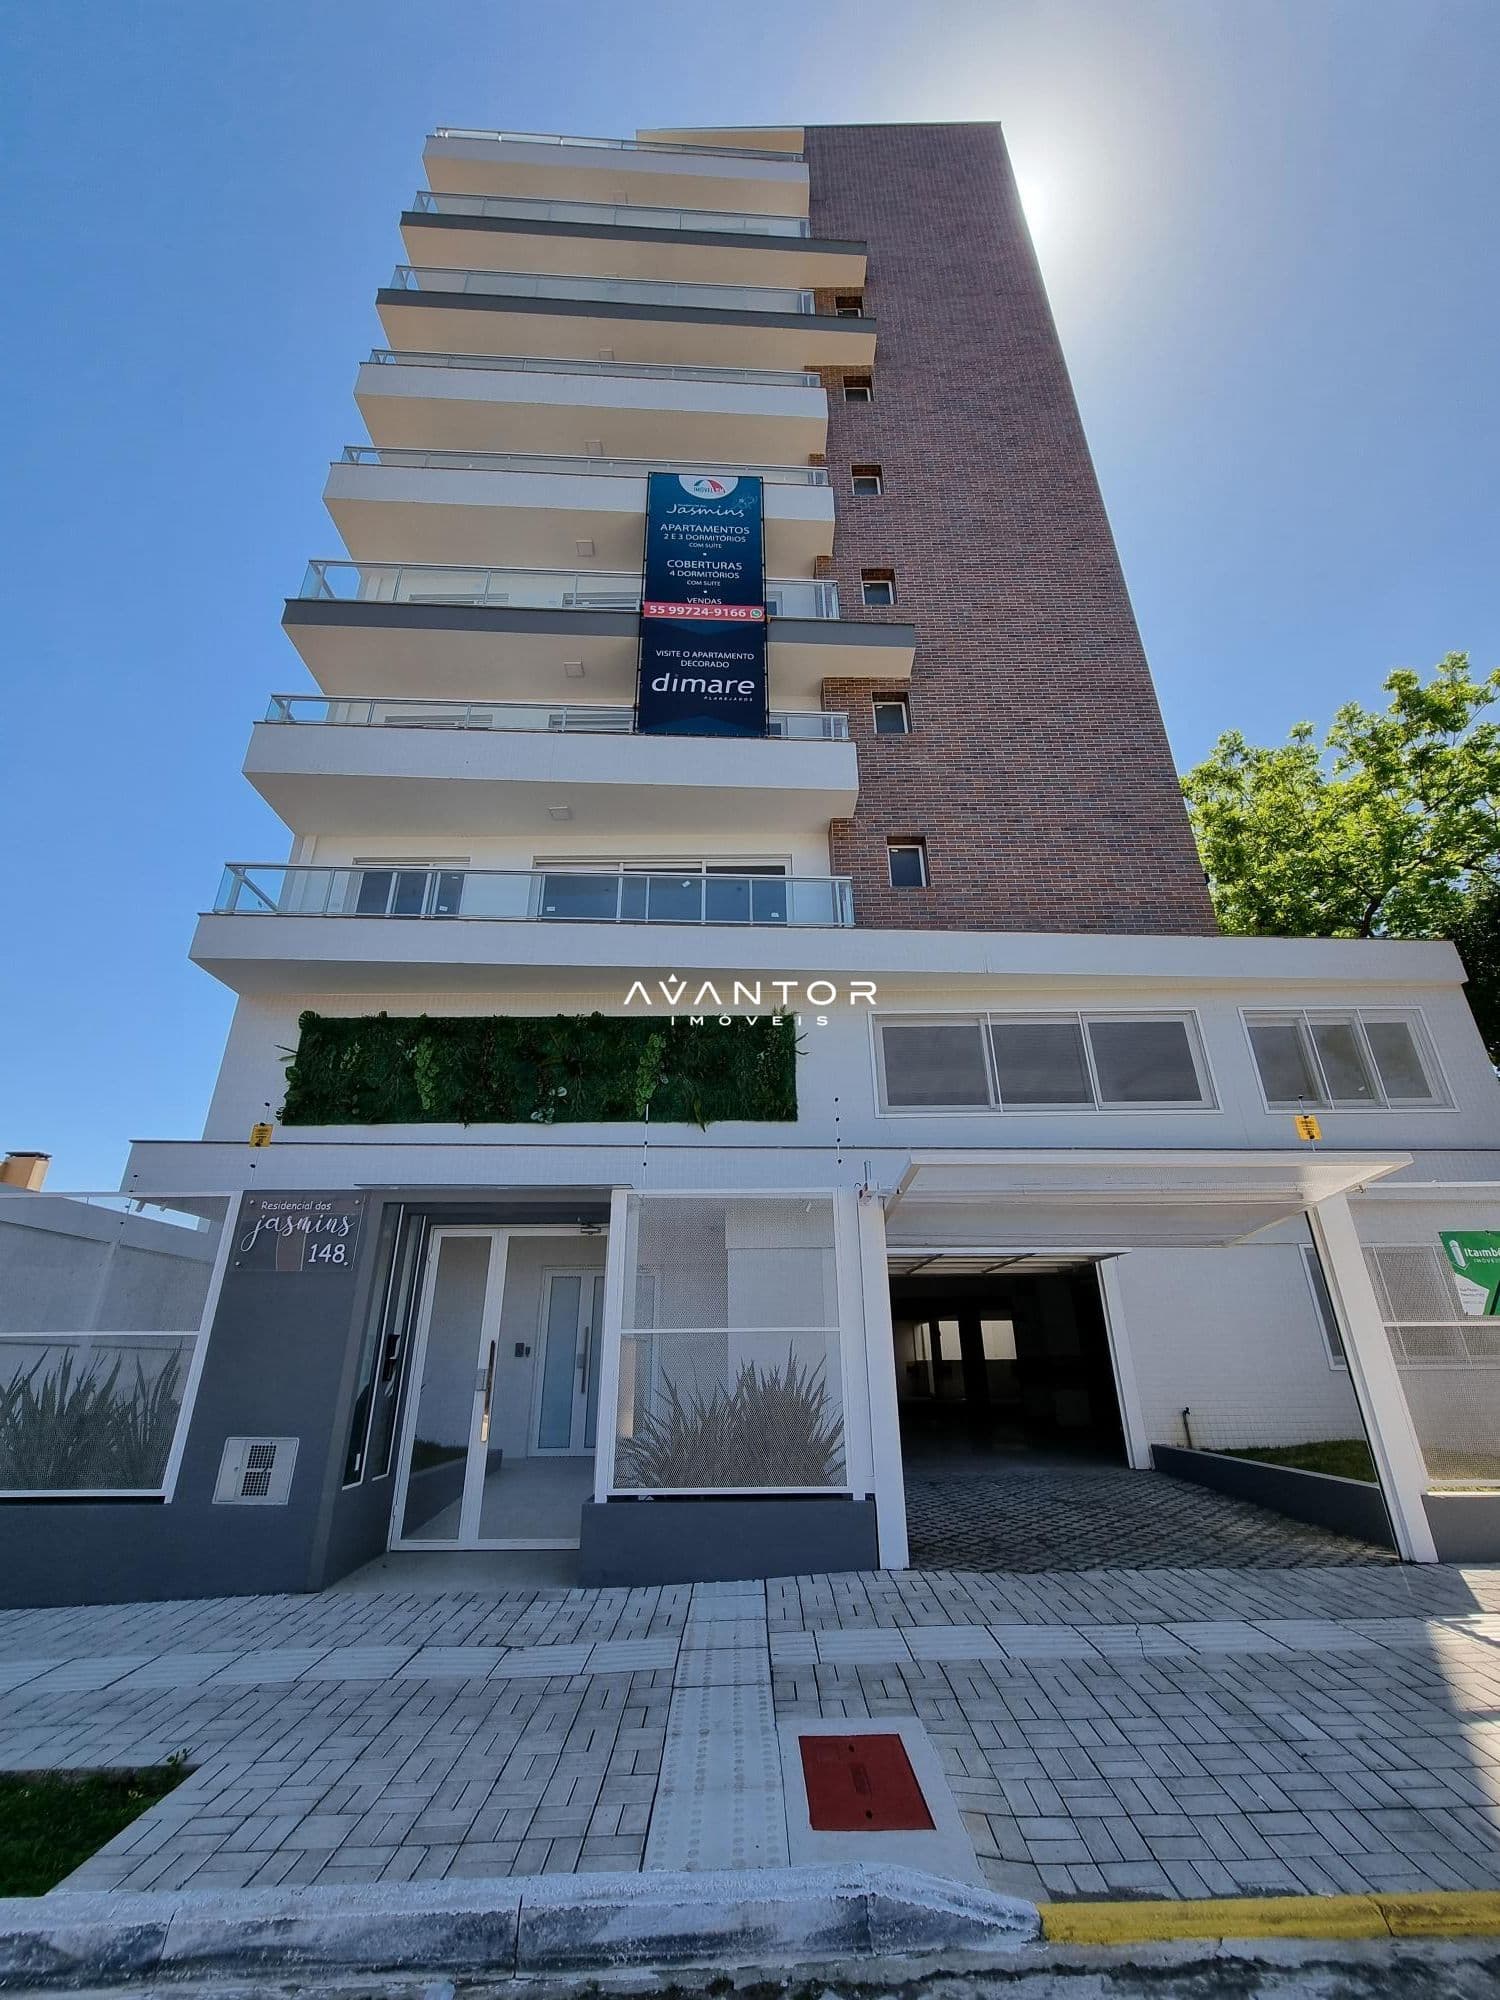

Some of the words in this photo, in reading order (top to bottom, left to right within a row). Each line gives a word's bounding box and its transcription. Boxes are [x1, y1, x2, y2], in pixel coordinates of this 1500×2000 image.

[666, 503, 745, 518] Jasmins
[660, 523, 750, 535] APARTAMENTOS
[686, 534, 746, 542] DORMITÓRIOS
[667, 559, 742, 570] COBERTURAS
[677, 570, 740, 579] DORMITÓRIOS
[649, 605, 665, 614] 55
[668, 606, 746, 617] 99724-9166
[692, 651, 755, 660] APARTAMENTO
[680, 660, 730, 668] DECORADO
[651, 672, 755, 694] dimare
[261, 1200, 313, 1210] Residencial
[315, 1201, 332, 1210] dos
[240, 1214, 355, 1252] jasmins
